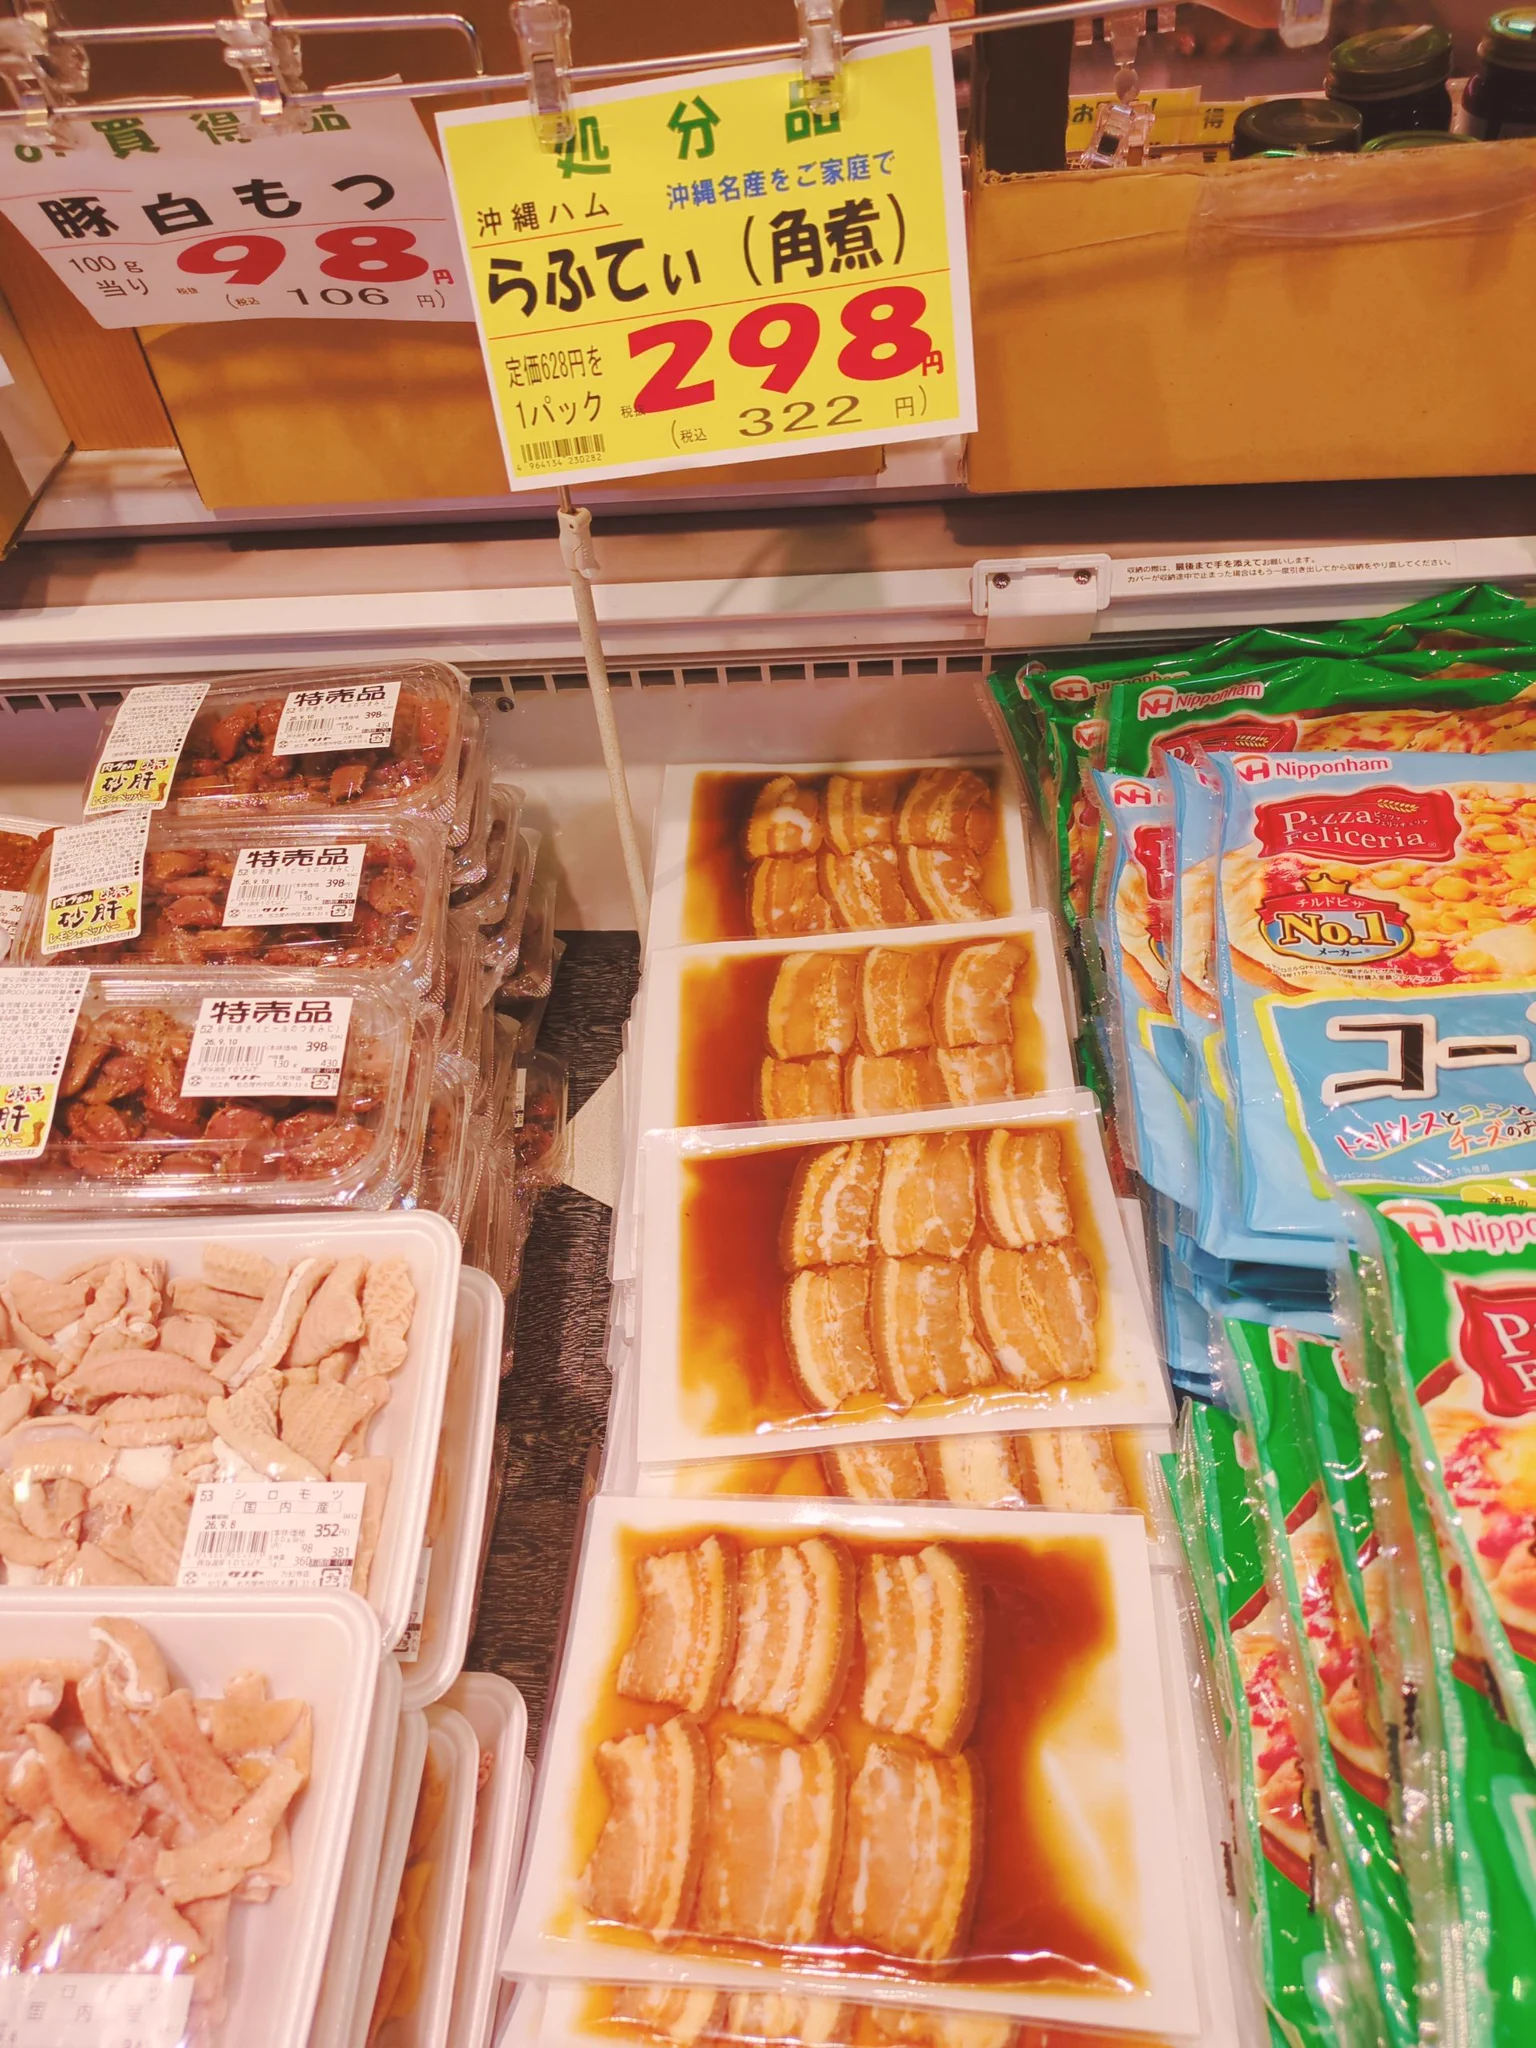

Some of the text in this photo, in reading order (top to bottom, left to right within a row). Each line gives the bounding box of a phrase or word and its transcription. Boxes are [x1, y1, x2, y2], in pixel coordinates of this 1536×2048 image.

[666, 150, 895, 211] 沖縄名産をご家庭で
[38, 174, 396, 240] 豚白もつ
[476, 192, 610, 238] 沖縄ハム
[176, 226, 430, 286] 98
[97, 278, 150, 299] 当り
[287, 287, 389, 307] 106
[627, 285, 932, 415] 298
[505, 344, 604, 388] 定価628円を
[515, 388, 603, 430] 1パック
[738, 395, 863, 438] 322
[293, 685, 386, 706] 特売品
[1175, 684, 1261, 709] Nipponham
[364, 710, 382, 719] 398
[1276, 758, 1389, 779] Nipponham
[101, 771, 157, 793] 砂肝
[1279, 810, 1374, 834] Pizza
[1284, 826, 1427, 849] Feliceria
[245, 847, 350, 868] 特売品
[325, 879, 345, 888] 398
[1296, 896, 1366, 909] チルドピザ
[57, 900, 123, 929] 砂肝
[1276, 911, 1397, 946] No.1
[210, 1000, 333, 1024] 特売品
[305, 1041, 328, 1052] 398
[273, 1059, 338, 1068] 130 430
[200, 1488, 344, 1502] 53 シロモツ
[243, 1501, 330, 1514] 国内産
[314, 1523, 340, 1538] 352
